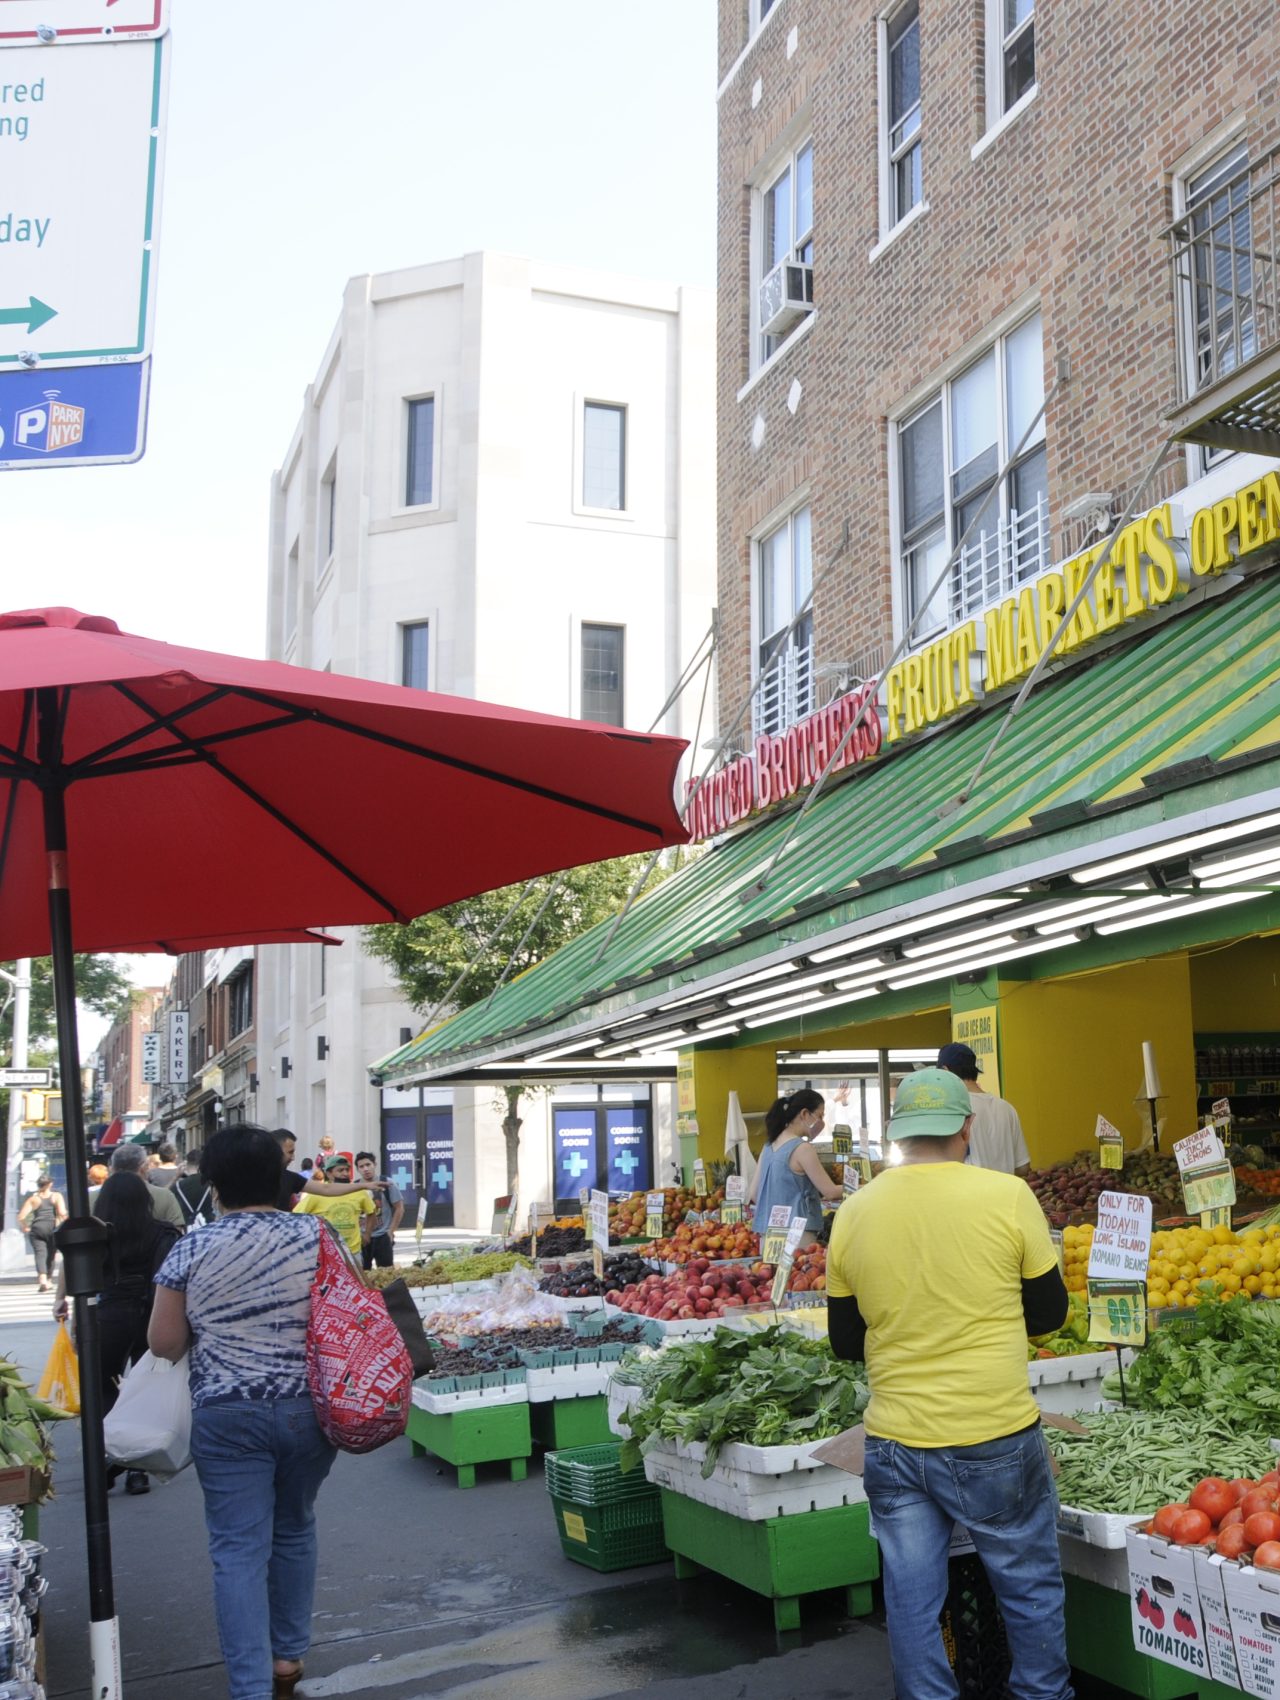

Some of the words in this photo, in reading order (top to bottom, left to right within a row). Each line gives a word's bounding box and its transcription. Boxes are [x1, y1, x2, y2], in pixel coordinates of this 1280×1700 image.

[52, 405, 81, 423] PARK
[50, 423, 81, 447] NYC
[684, 754, 753, 845] UNITED
[755, 680, 884, 809] BROTHERS
[886, 620, 980, 743] FRUIT
[983, 502, 1184, 693] MARKETS
[970, 1018, 980, 1037] ICE
[980, 1016, 991, 1034] BAG
[174, 1014, 184, 1080] BAKERY
[558, 1127, 593, 1137] COMING
[610, 1126, 643, 1136] COMING
[1174, 1128, 1212, 1153] CALIFORNIA
[386, 1141, 417, 1151] COMING
[1182, 1145, 1213, 1167] LEMONS
[1184, 1140, 1205, 1157] JUICY
[1100, 1193, 1123, 1209] ONLY
[1127, 1196, 1145, 1214] FOR
[1099, 1212, 1140, 1236] TODAY!!!
[1093, 1231, 1114, 1246] LONG
[1117, 1235, 1147, 1253] ISLAND
[1091, 1248, 1122, 1267] ROMANO
[1124, 1255, 1148, 1273] BEANS
[1107, 1297, 1132, 1337] 99
[1138, 1624, 1205, 1669] TOMATOES
[1239, 1635, 1274, 1655] TOMATOES
[1261, 1631, 1278, 1643] GROWN
[1252, 1662, 1269, 1675] LARGE
[1259, 1655, 1276, 1668] LARGE
[1254, 1673, 1276, 1687] MEDIUM
[1256, 1682, 1273, 1696] SMALL
